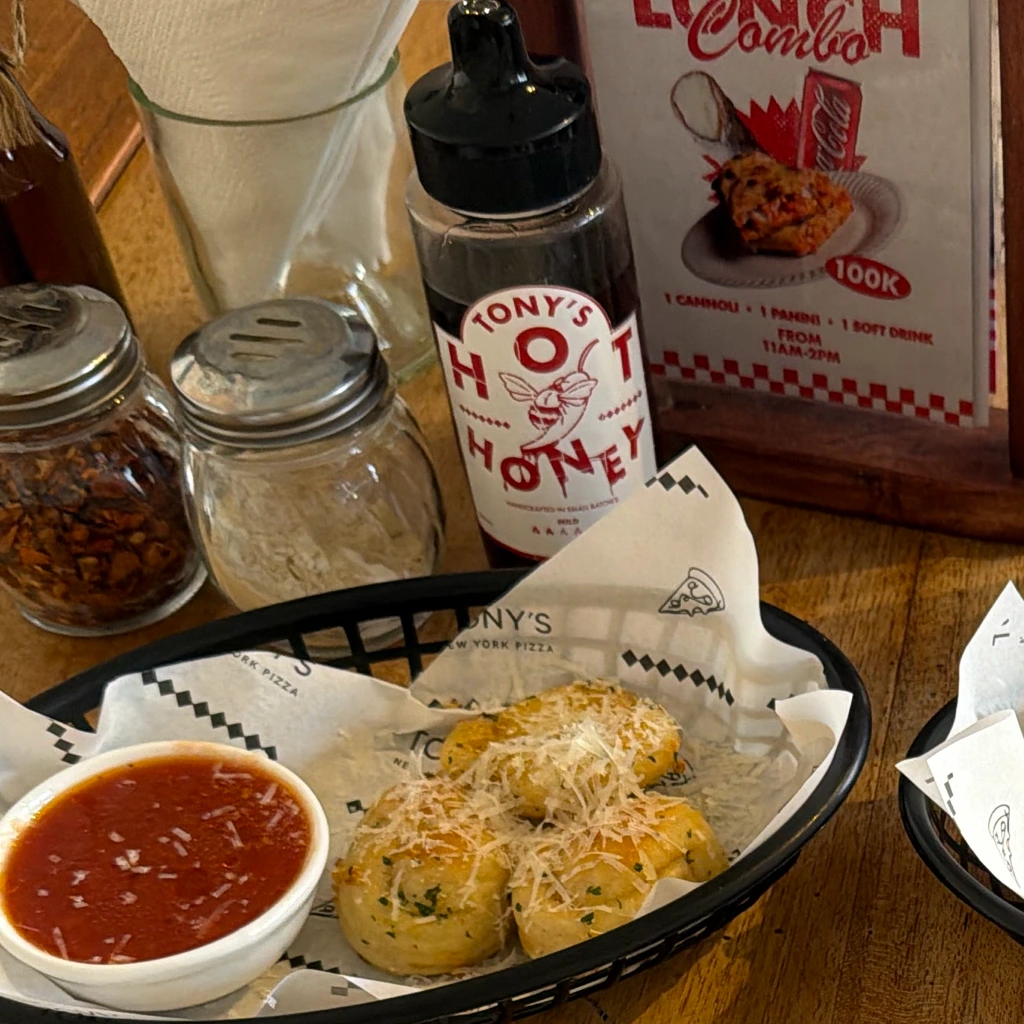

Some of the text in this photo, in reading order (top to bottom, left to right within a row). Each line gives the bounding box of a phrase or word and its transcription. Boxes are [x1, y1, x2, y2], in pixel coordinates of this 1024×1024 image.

[687, 0, 869, 65] Combo
[835, 258, 900, 297] 100K
[472, 294, 594, 334] TONY'S
[675, 294, 740, 314] CANNOLI
[771, 308, 821, 327] PANINI
[853, 320, 886, 337] SOFT
[888, 326, 935, 346] DRINK
[762, 340, 841, 364] 11AM-2PM
[777, 328, 823, 347] FROM
[447, 326, 634, 401] HOT
[465, 417, 645, 496] HONEY
[469, 608, 552, 634] NY'S
[473, 639, 509, 650] YORK
[515, 641, 554, 653] PIZZA
[232, 651, 260, 670] ORK
[261, 668, 299, 697] PIZZA
